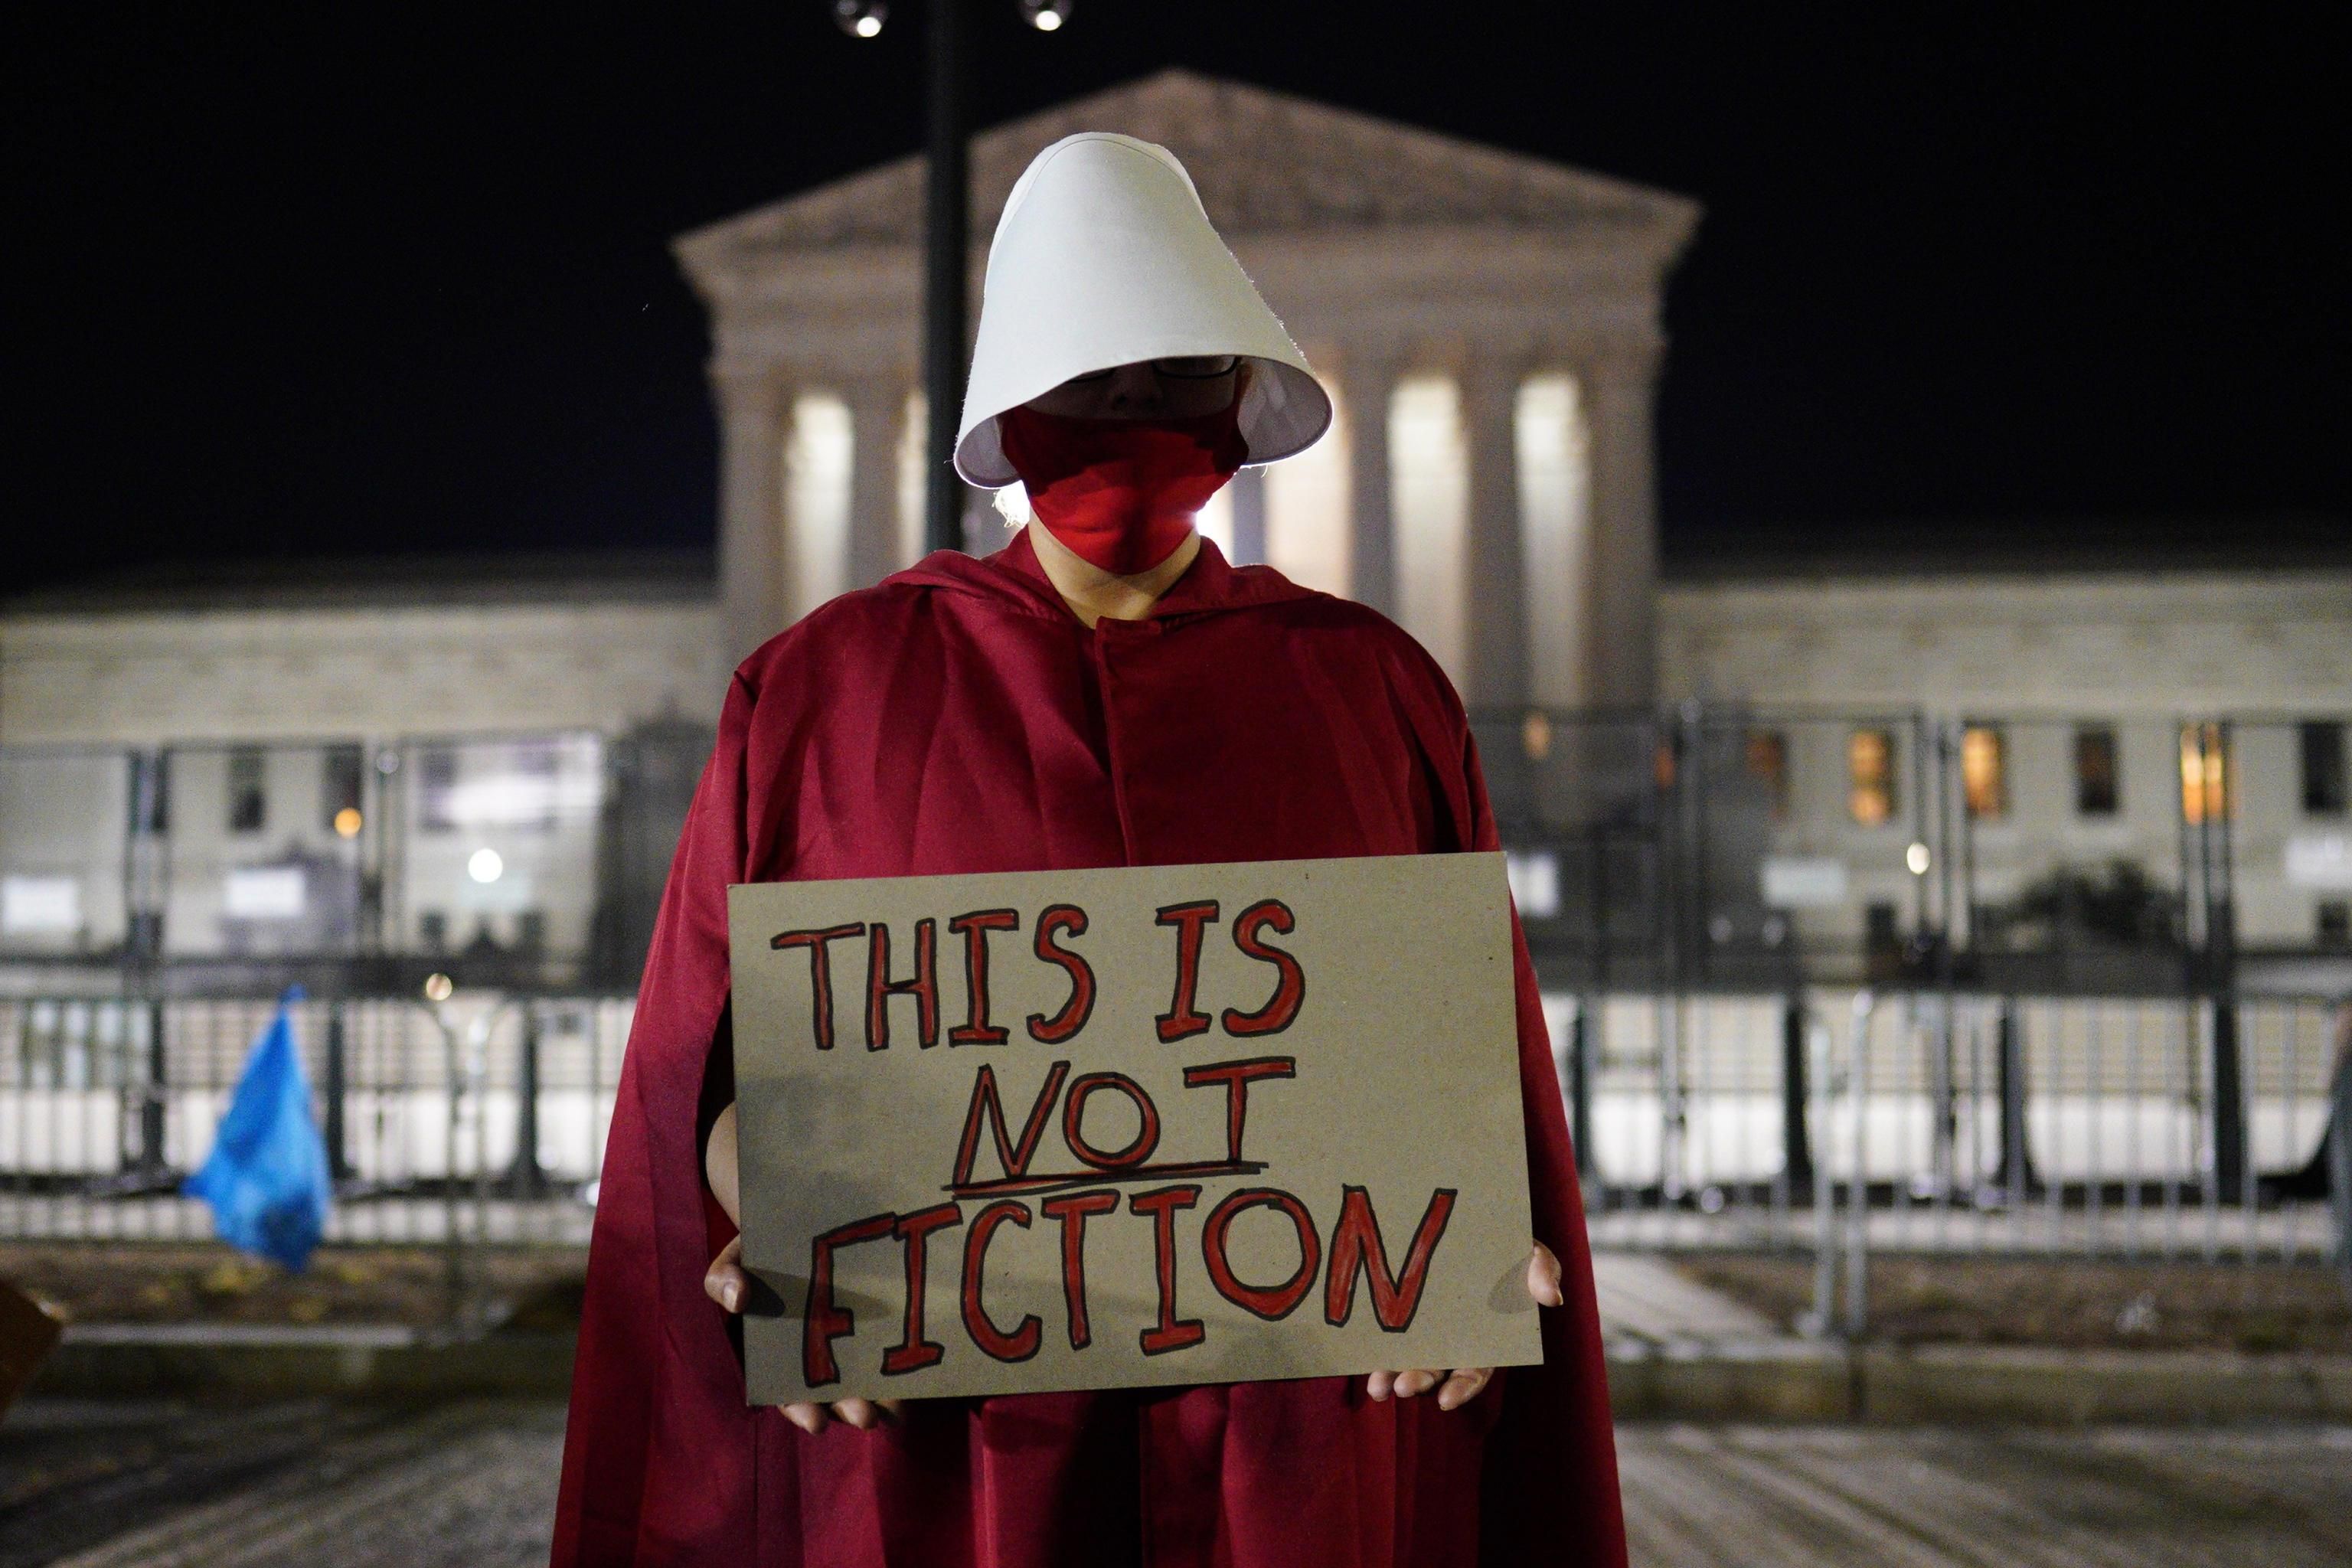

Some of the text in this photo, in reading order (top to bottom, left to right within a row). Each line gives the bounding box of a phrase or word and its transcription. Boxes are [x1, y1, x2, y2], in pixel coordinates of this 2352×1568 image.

[771, 899, 1306, 1051] THIS IS
[952, 1056, 1296, 1188] NOT
[802, 1184, 1458, 1387] FICTION
